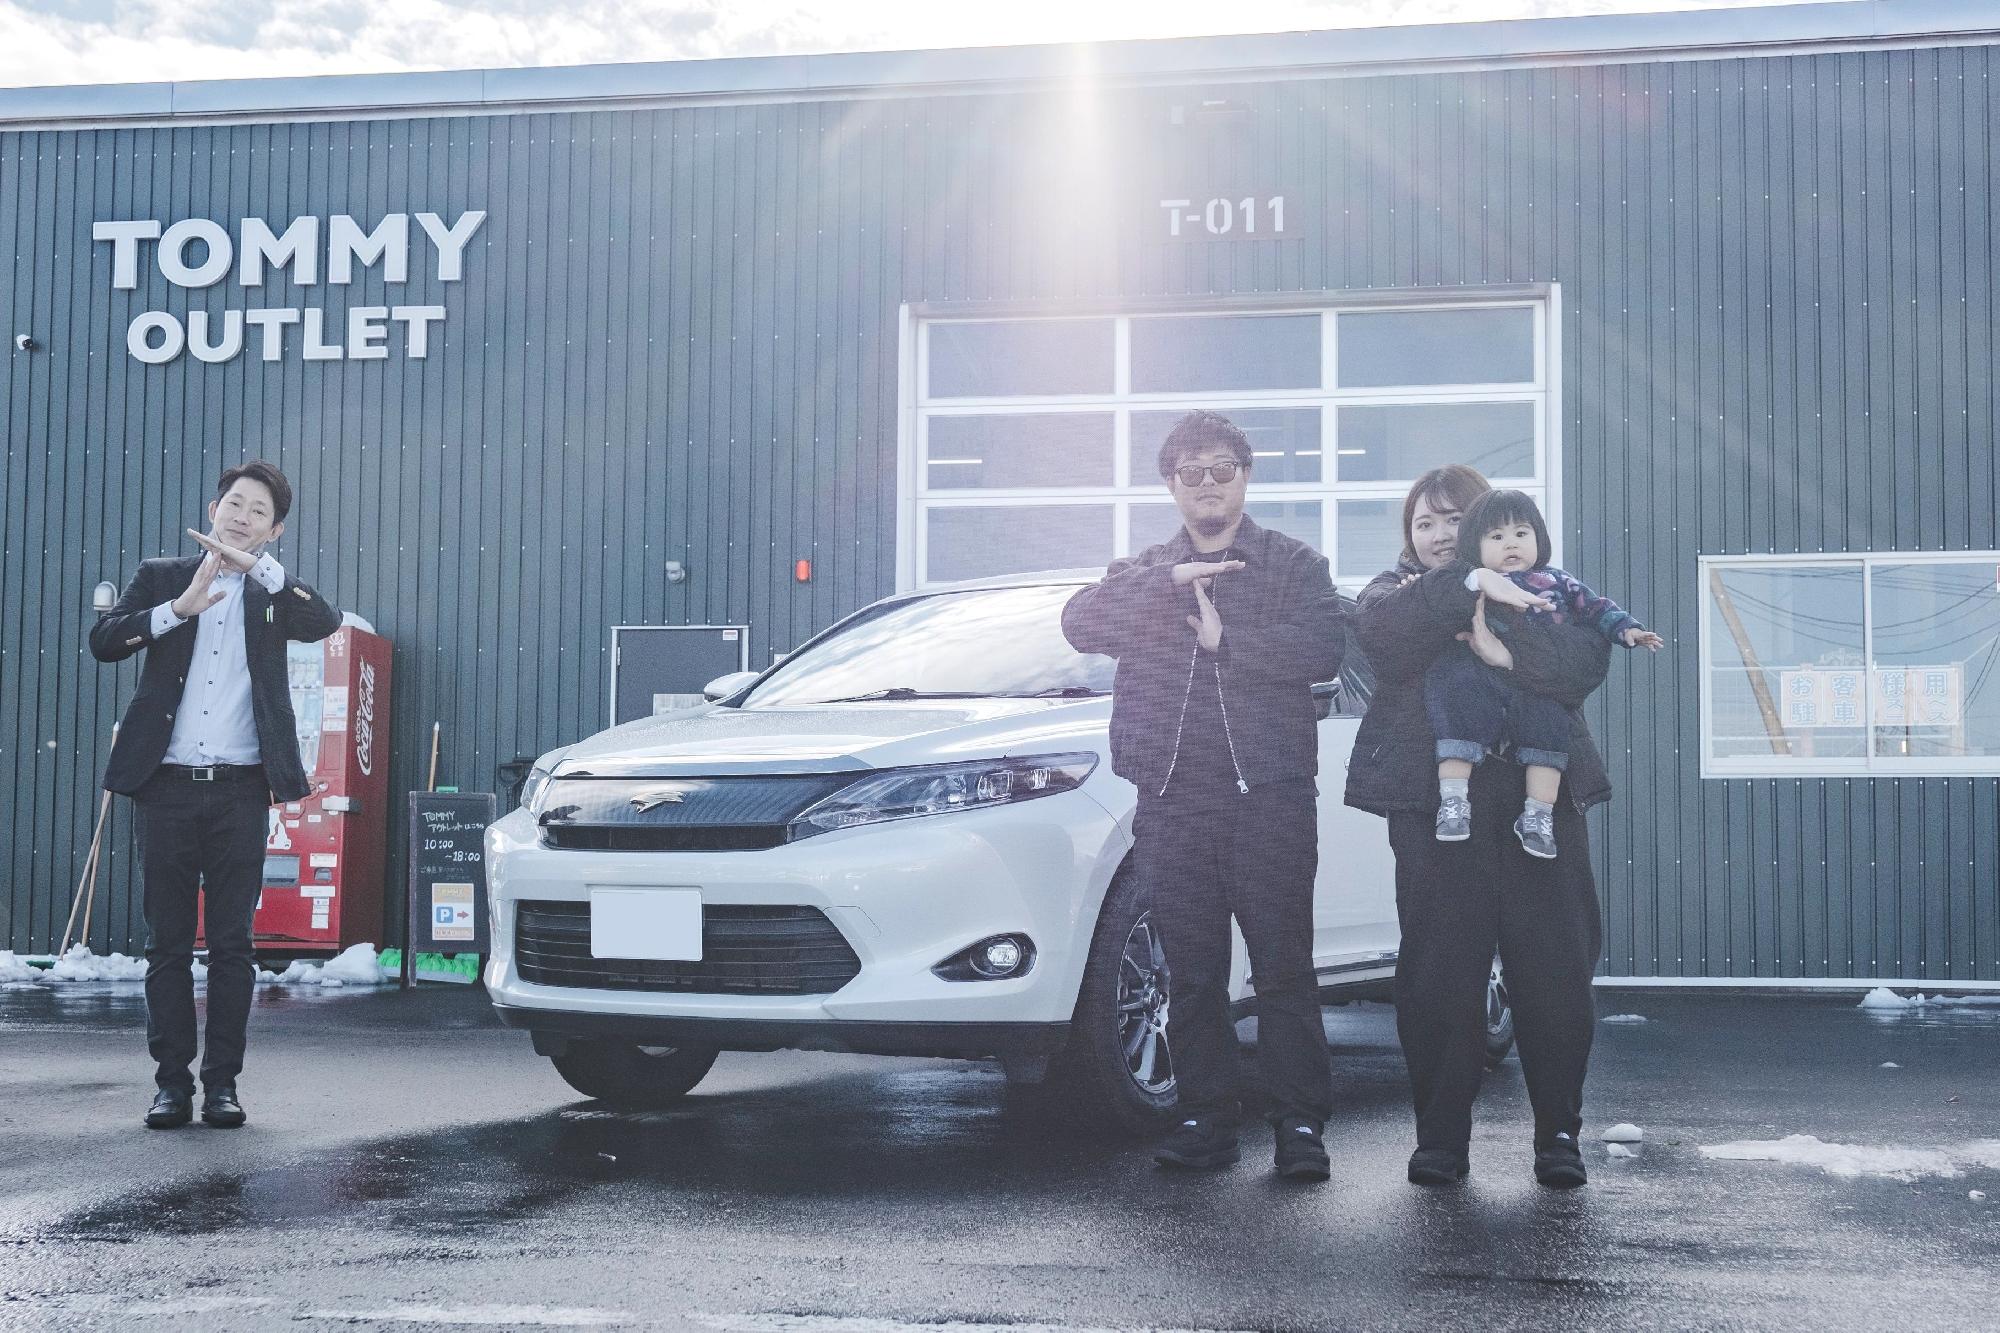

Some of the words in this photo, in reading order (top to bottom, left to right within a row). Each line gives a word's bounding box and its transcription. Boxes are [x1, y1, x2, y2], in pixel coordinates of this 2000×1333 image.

[1160, 196, 1284, 235] T-011
[93, 210, 486, 290] TOMMY
[127, 305, 446, 363] OUTLET
[1790, 672, 1948, 697] お客様用
[357, 655, 374, 775] Coca-Cola
[422, 810, 455, 822] TOMMY
[424, 839, 454, 850] 10:00
